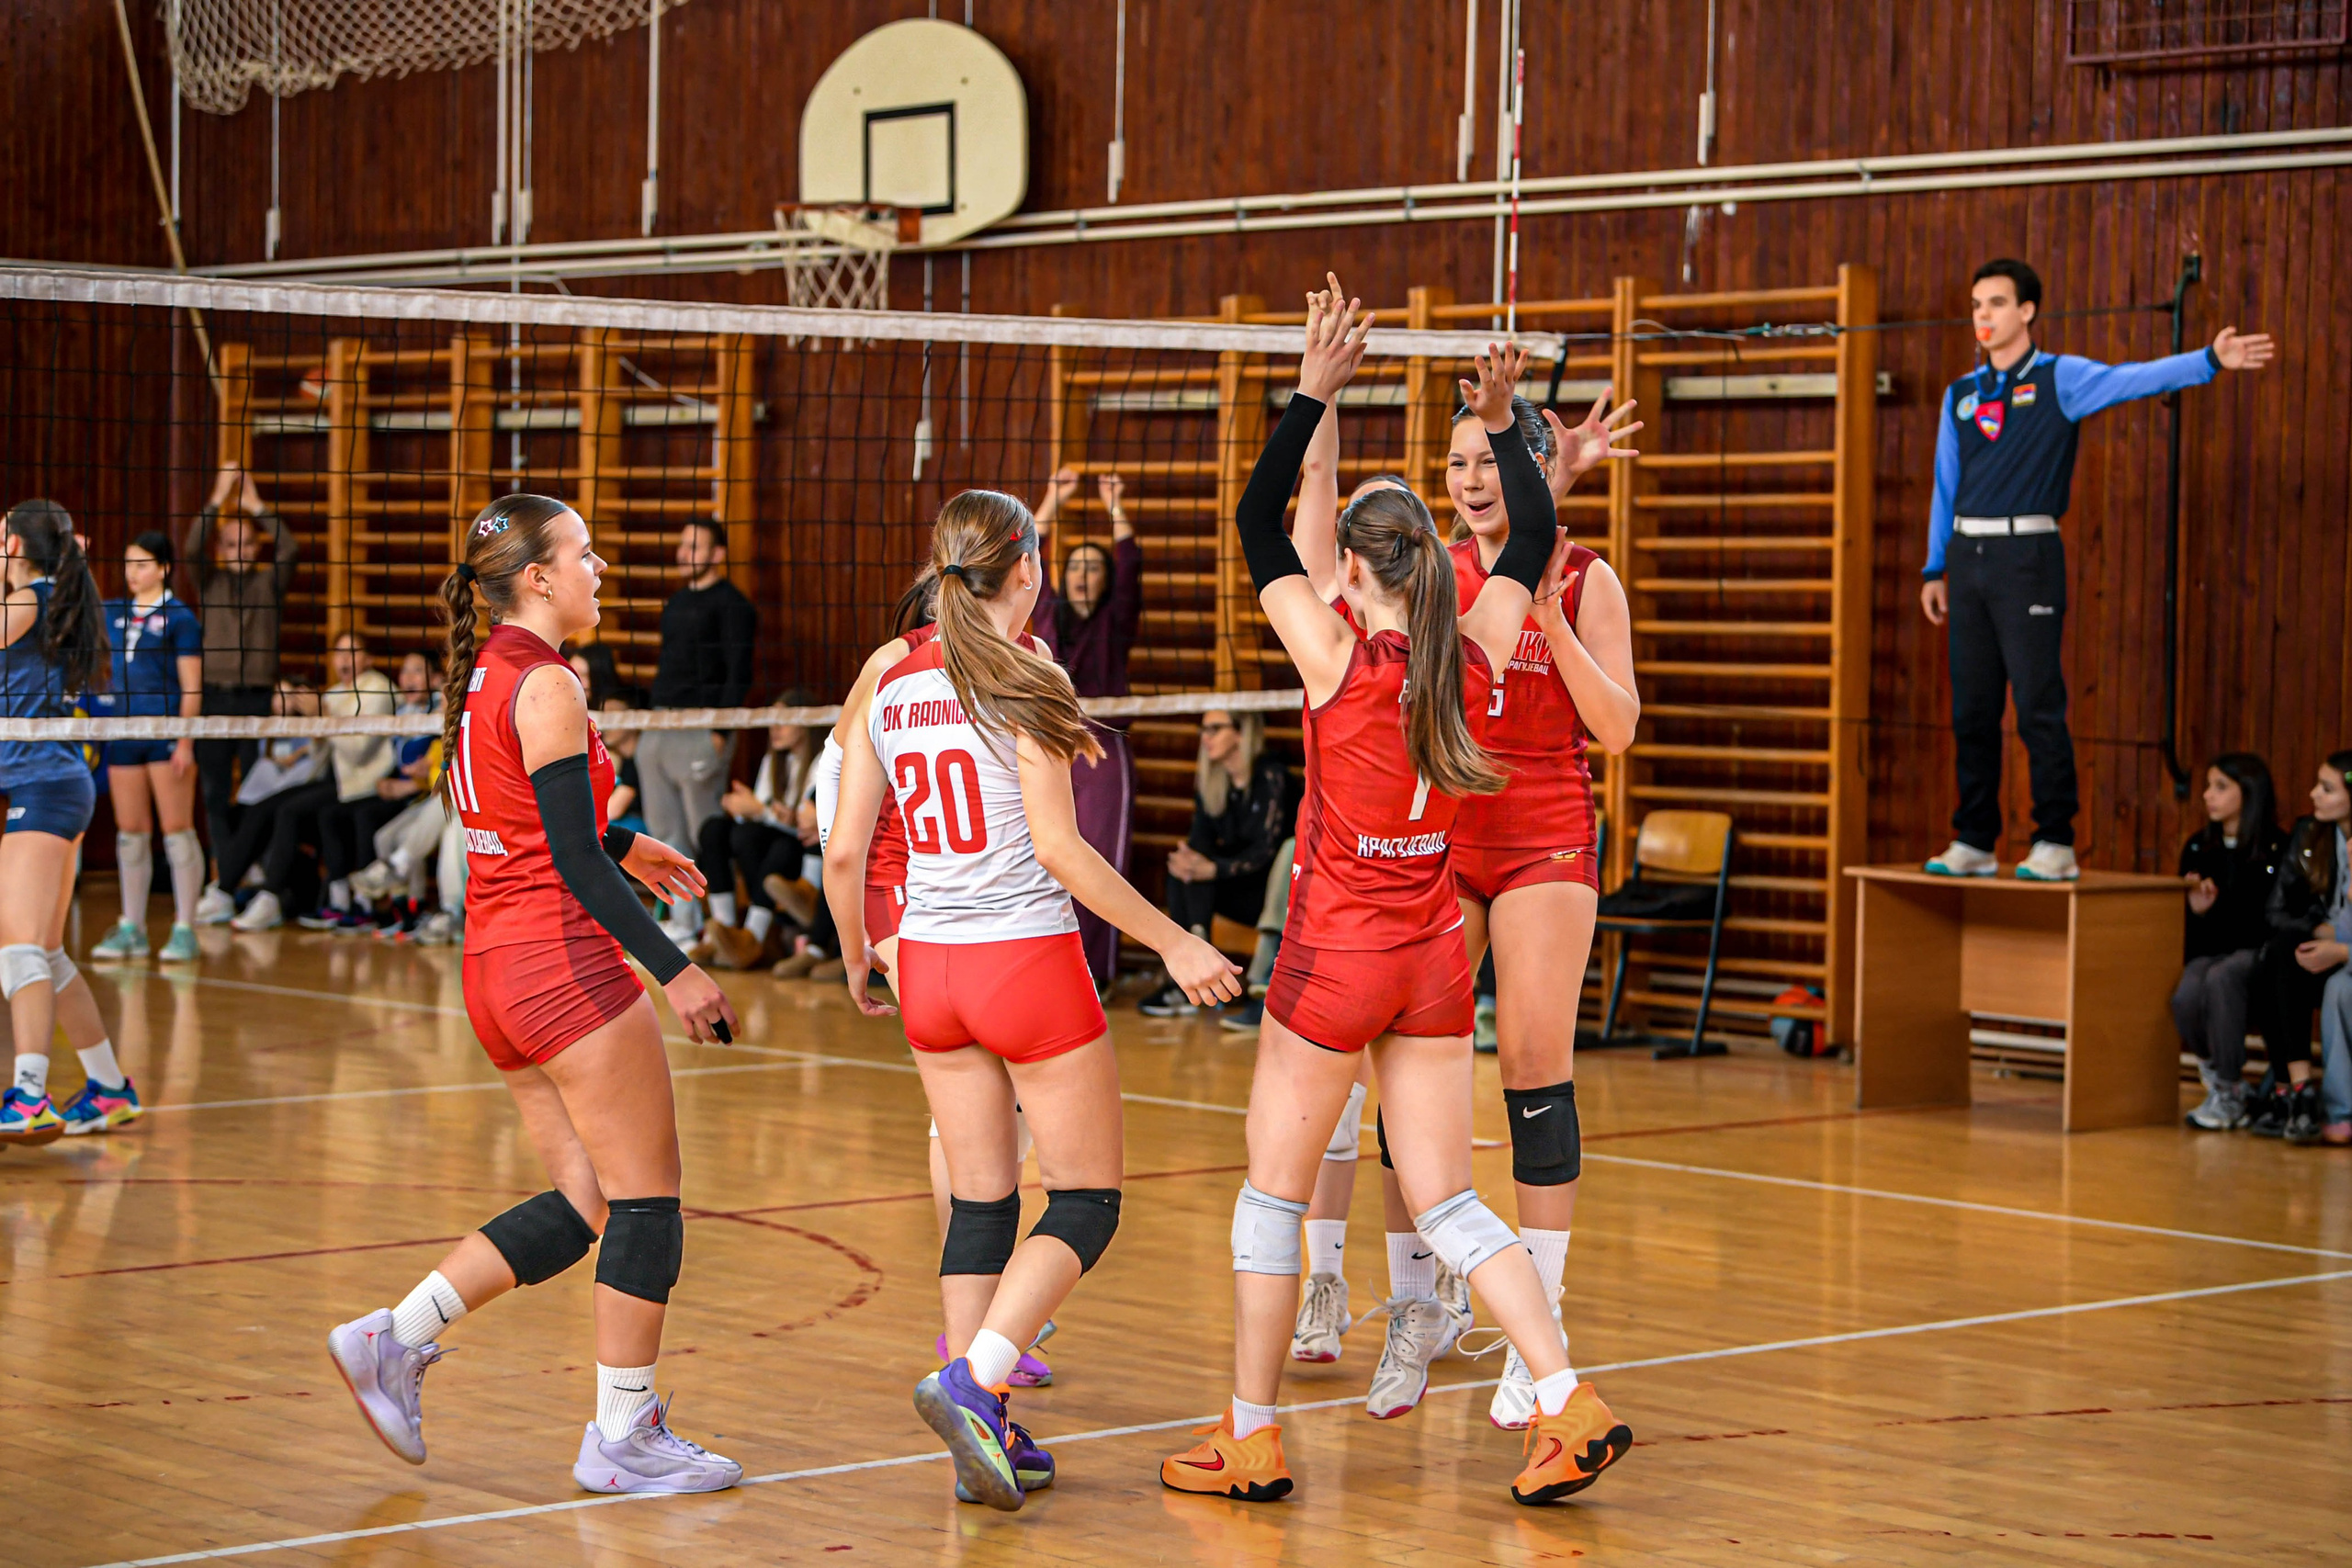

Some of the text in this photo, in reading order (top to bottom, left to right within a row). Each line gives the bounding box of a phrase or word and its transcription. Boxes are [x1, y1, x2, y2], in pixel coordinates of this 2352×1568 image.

[1507, 660, 1549, 675] РАГУЈЕВАЦ
[895, 749, 988, 854] 20
[1357, 829, 1446, 858] КРАГУЈЕВАЦ
